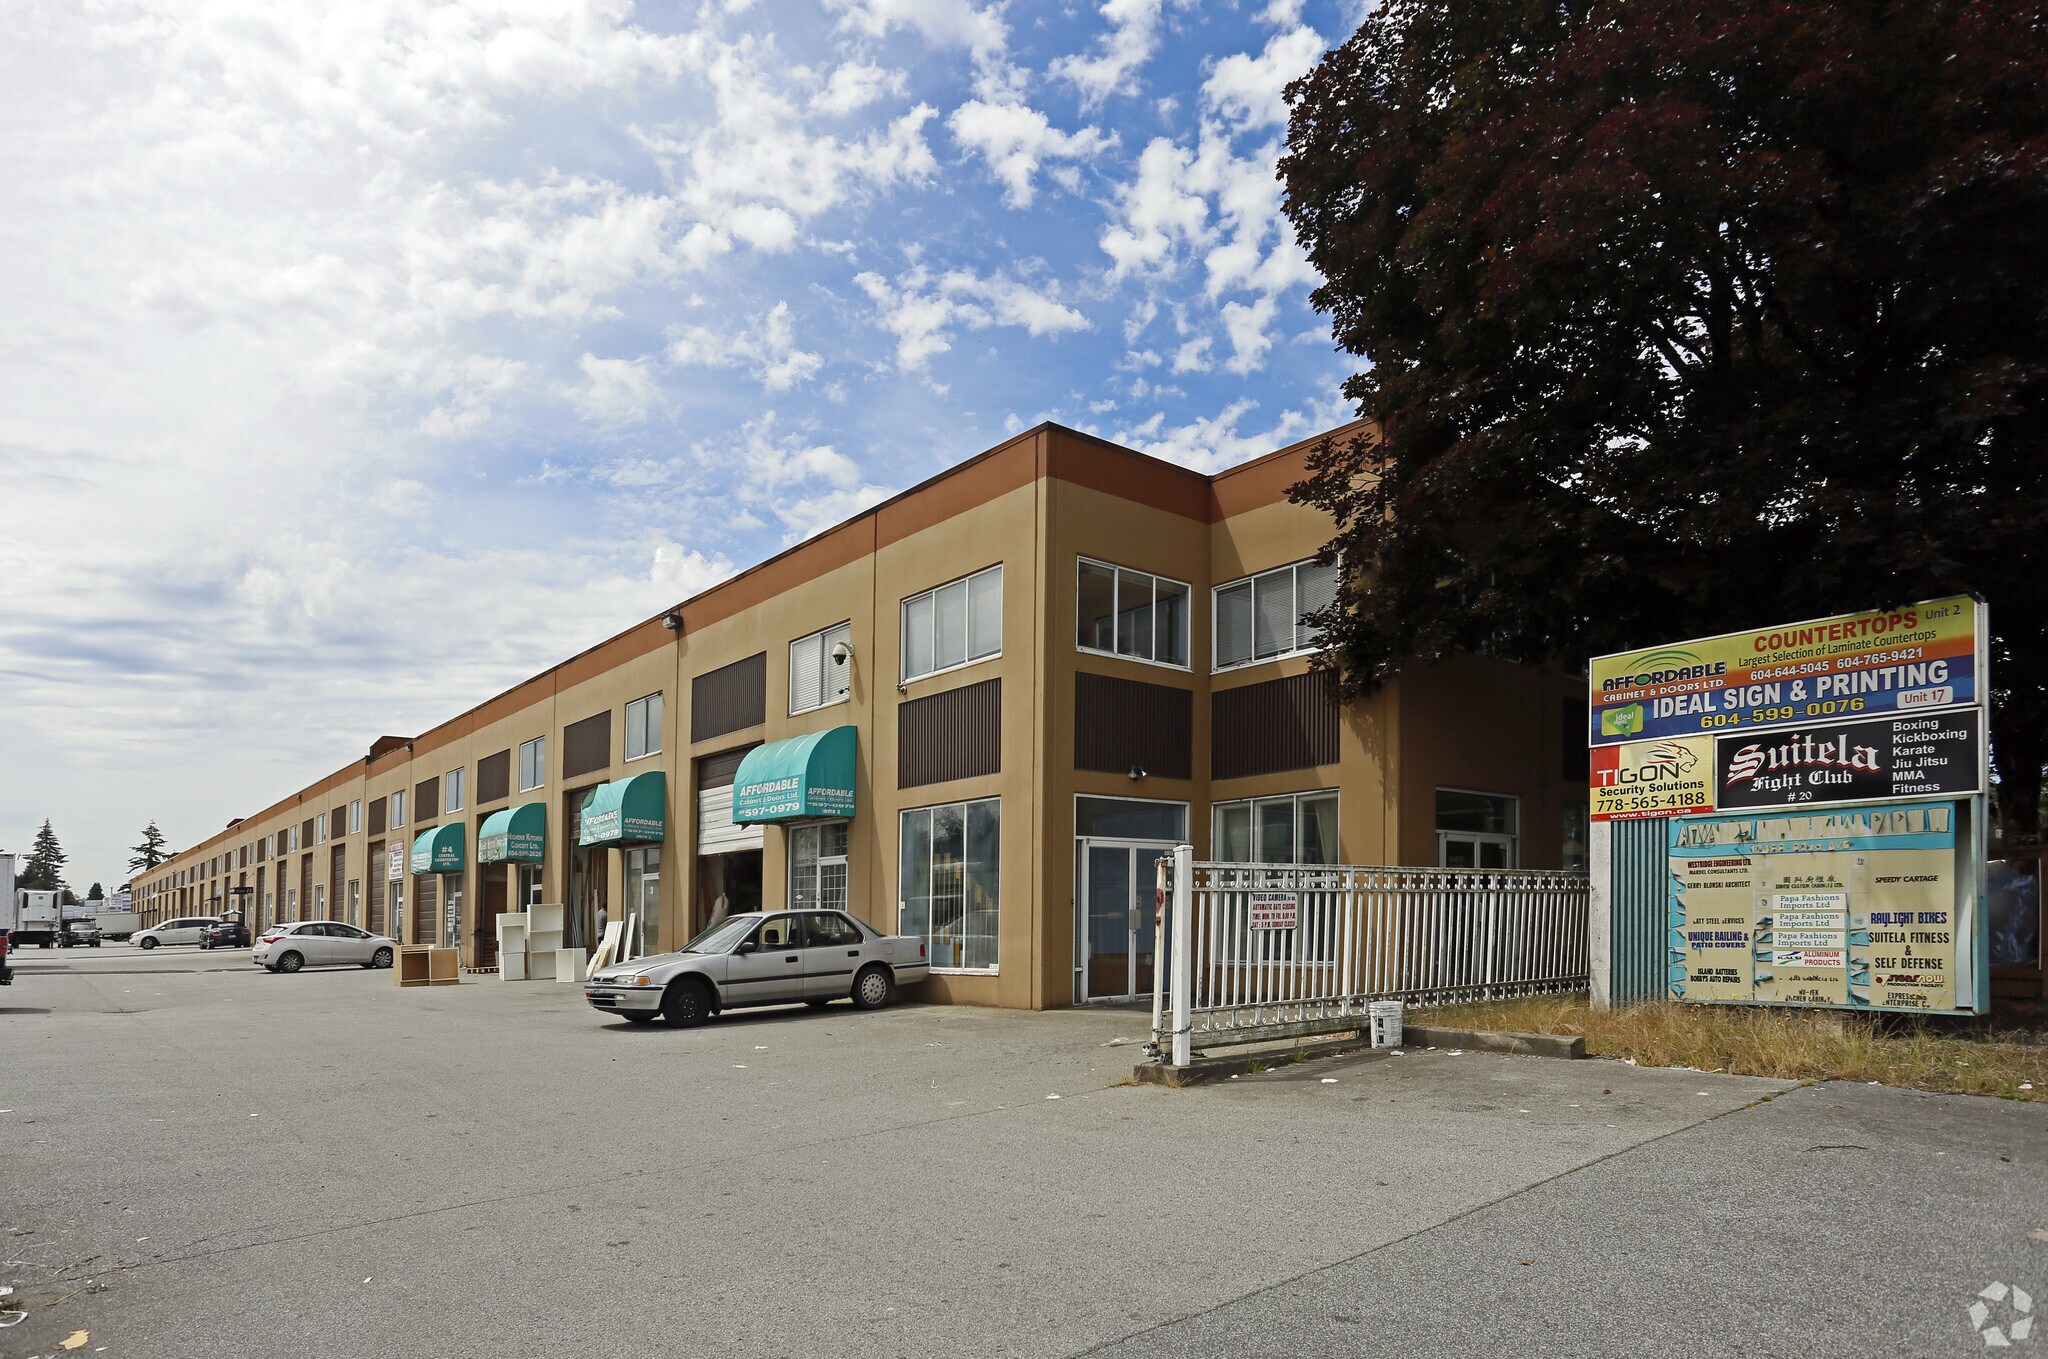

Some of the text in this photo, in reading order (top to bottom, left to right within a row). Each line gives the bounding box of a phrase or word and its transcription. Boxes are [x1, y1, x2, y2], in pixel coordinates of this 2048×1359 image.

[1925, 604, 1961, 620] Unit 2
[1754, 611, 1918, 652] COUNTERTOPS
[1738, 629, 1936, 668] Largest Selection of Laminate Countertops
[1750, 647, 1923, 681] 604-644-5045 604-765-9421
[1602, 662, 1727, 692] AFFORDABLE
[1603, 690, 1646, 703] CABINET
[1660, 682, 1700, 695] DOORS
[1703, 680, 1727, 689] LTD.
[1653, 661, 1949, 719] IDEAL SIGN & PRINTING
[1904, 688, 1946, 704] Unit 17
[1615, 711, 1634, 721] ideal
[1700, 697, 1865, 729] 604-599-0076
[1892, 719, 1939, 733] Boxing
[1892, 729, 1967, 744] Kickboxing
[1892, 745, 1936, 757] Karate
[1726, 733, 1880, 787] Suitela
[1892, 757, 1948, 769] Jiu Jitsu
[1597, 763, 1679, 786] TIGON
[1750, 769, 1852, 792] Fight Club
[1892, 771, 1925, 782] MMA
[740, 778, 799, 797] AFFORDABLE
[808, 787, 853, 797] AFFORDABLE
[1599, 781, 1704, 797] Security Solutions
[1892, 783, 1940, 794] Fitness
[739, 798, 761, 806] Cabinet
[787, 791, 798, 799] Ltd.
[1597, 792, 1705, 812] 778-565-4188
[1787, 791, 1812, 802] # 20
[745, 802, 800, 817] 597-0979
[1610, 808, 1692, 819] www.tigon.ca
[624, 818, 663, 827] AFFORDABLE
[1687, 860, 1713, 868] WESTRIDGE
[1714, 858, 1742, 867] ENGINEERING
[1875, 876, 1902, 884] SPEEDY
[1253, 893, 1267, 901] VIDEO
[1268, 893, 1287, 901] CAMERA
[1780, 895, 1799, 903] Papa
[1780, 902, 1813, 910] Imports
[1780, 920, 1813, 928] Imports
[1871, 912, 1914, 927] RAYLIGHT
[1918, 912, 1947, 924] BIKES
[1688, 931, 1749, 942] UNIQUE RAILING &
[1869, 932, 1949, 943] SUITELA FITNESS
[1905, 945, 1911, 956] &
[1875, 957, 1943, 969] SELF DEFENSE
[1709, 975, 1721, 983] AUTO
[1722, 976, 1741, 984] REPAIRS
